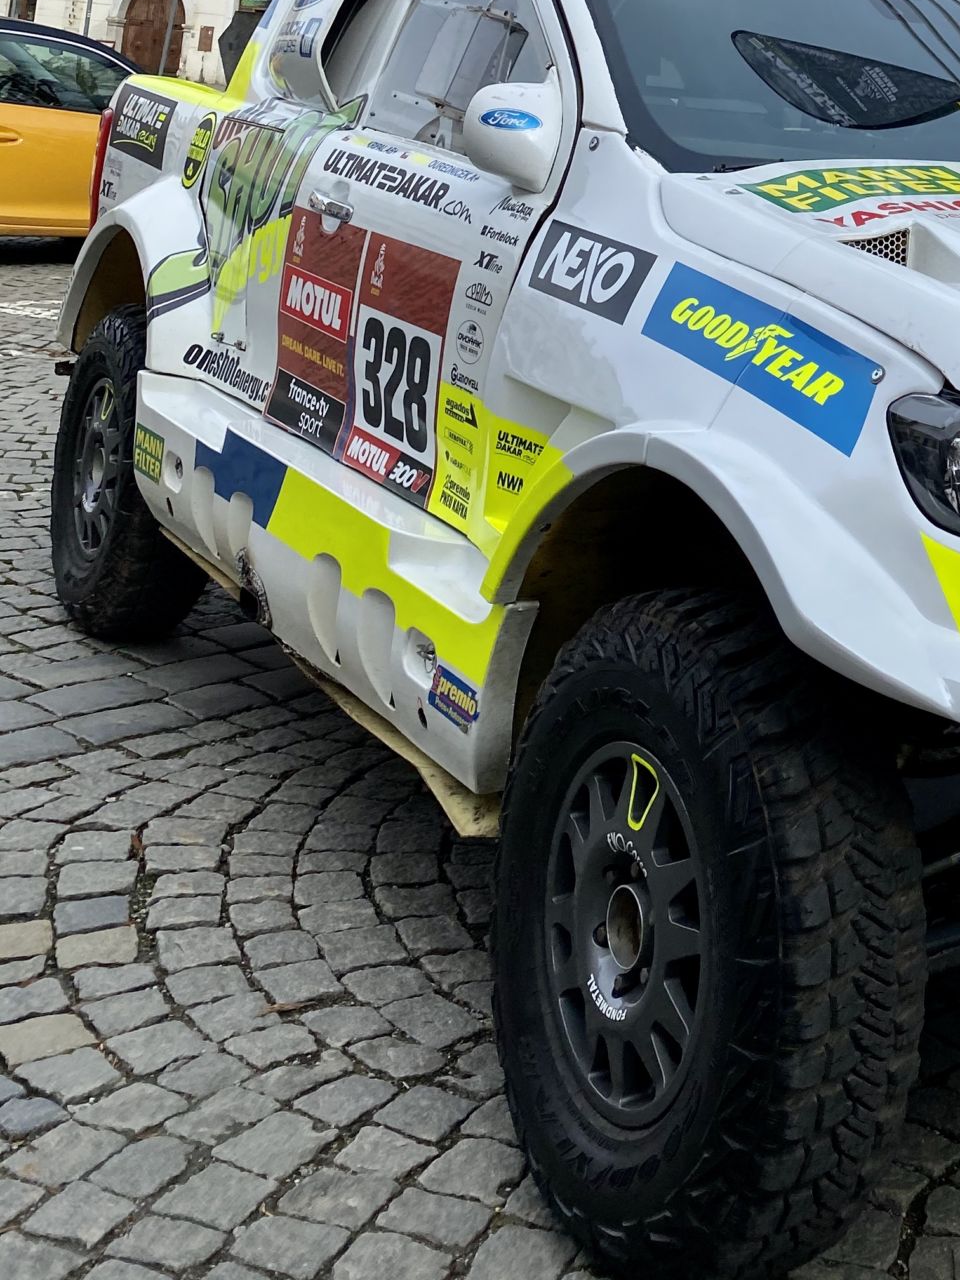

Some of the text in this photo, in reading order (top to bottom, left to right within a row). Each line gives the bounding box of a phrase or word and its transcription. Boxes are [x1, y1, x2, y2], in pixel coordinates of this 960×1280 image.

[116, 114, 141, 140] DAKAR
[122, 93, 171, 129] ULTIMATE
[488, 109, 529, 128] Ford
[485, 226, 520, 247] Fortelock
[473, 250, 503, 274] XTline
[538, 230, 636, 305] NEXO
[285, 273, 342, 331] MOTUL
[281, 333, 304, 357] DREAM.
[304, 346, 322, 365] DARE.
[322, 355, 336, 372] LIVE
[670, 296, 846, 407] GOODYEAR
[361, 316, 432, 453] 328
[298, 411, 324, 439] sport
[497, 429, 545, 456] ULTIMATE
[136, 427, 164, 461] MANN
[496, 441, 523, 457] DAKAR
[134, 448, 162, 480] FILTER
[346, 435, 391, 476] MOTUL
[388, 460, 431, 494] 300V
[437, 675, 477, 717] premio
[586, 973, 628, 1022] FONDMETAL
